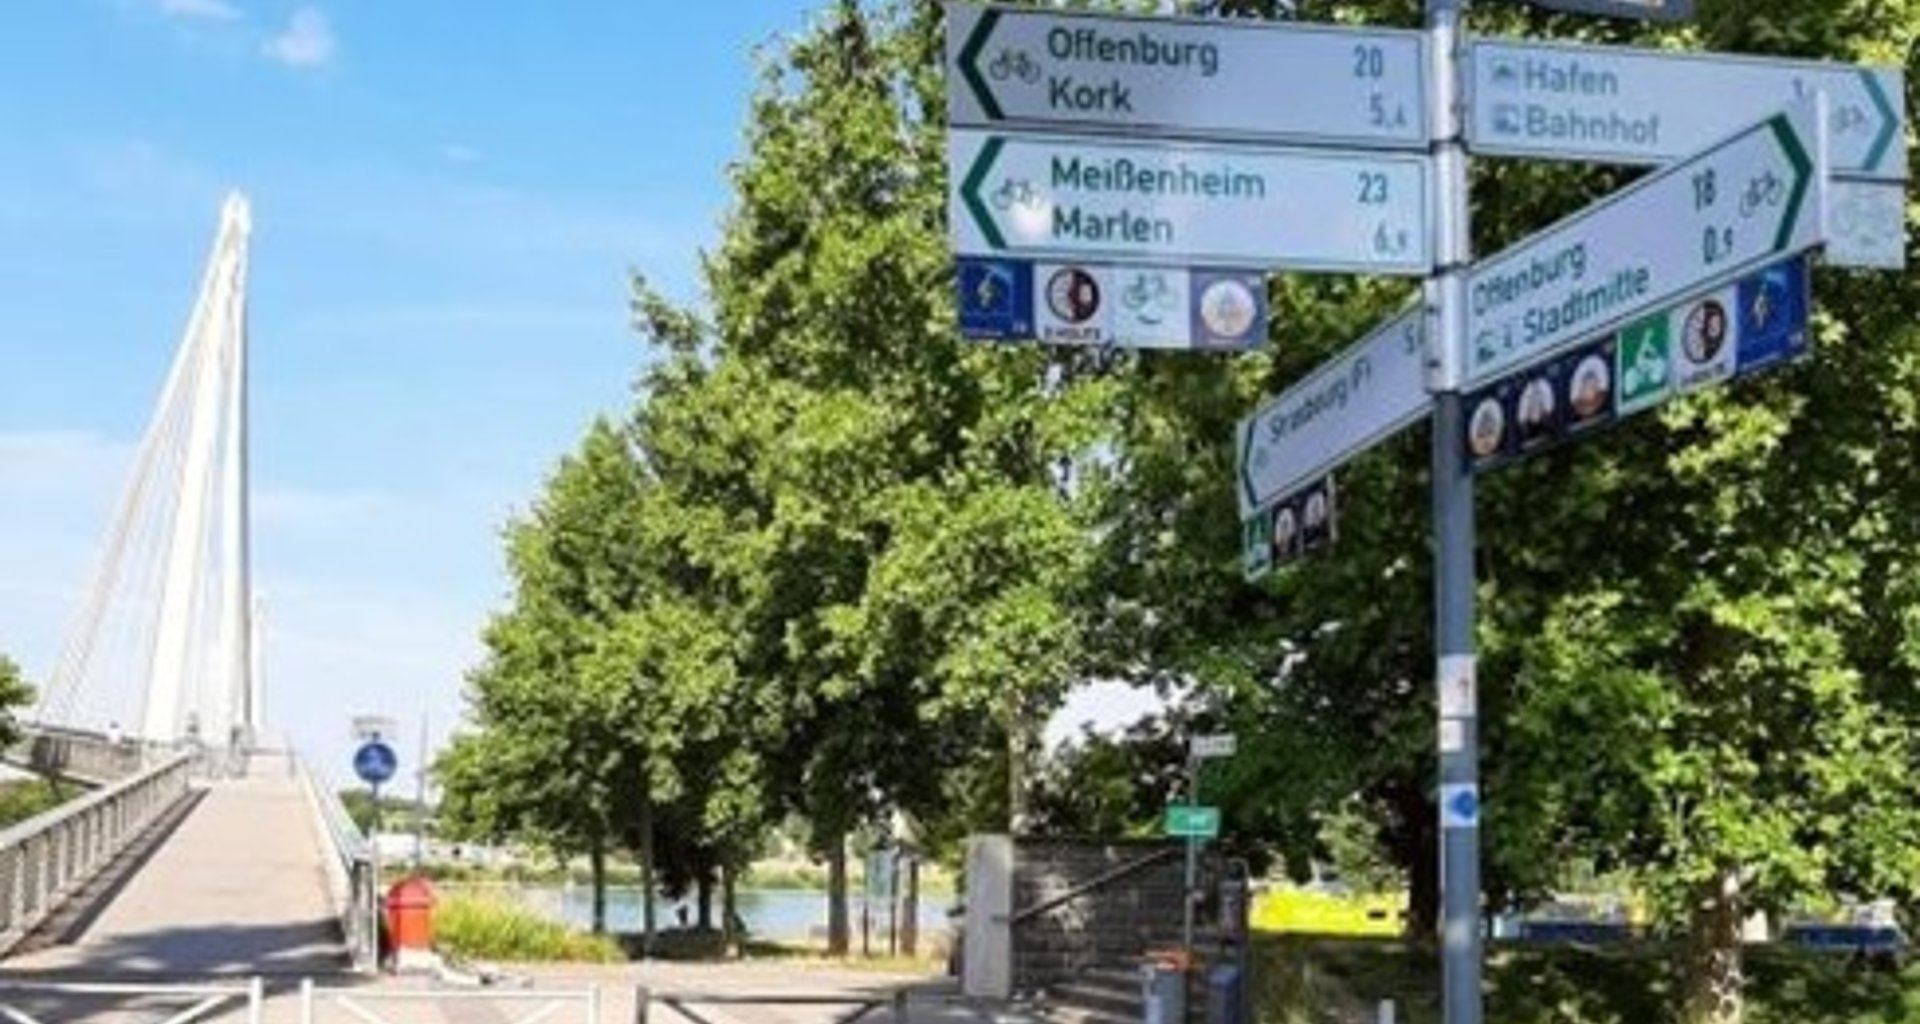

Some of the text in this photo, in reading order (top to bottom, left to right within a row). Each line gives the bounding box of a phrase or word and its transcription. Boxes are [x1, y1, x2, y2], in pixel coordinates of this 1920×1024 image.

[1047, 27, 1219, 76] Offenburg
[1353, 45, 1383, 78] 20
[1048, 77, 1134, 113] Kork
[1525, 62, 1619, 96] Hafen
[1525, 111, 1660, 146] Bahnhof
[1050, 155, 1267, 199] Meißenheim
[1358, 170, 1388, 204] 23
[1051, 206, 1174, 243] Marlen
[1472, 243, 1587, 317] Offenburg
[1523, 267, 1650, 345] Stadtmitte
